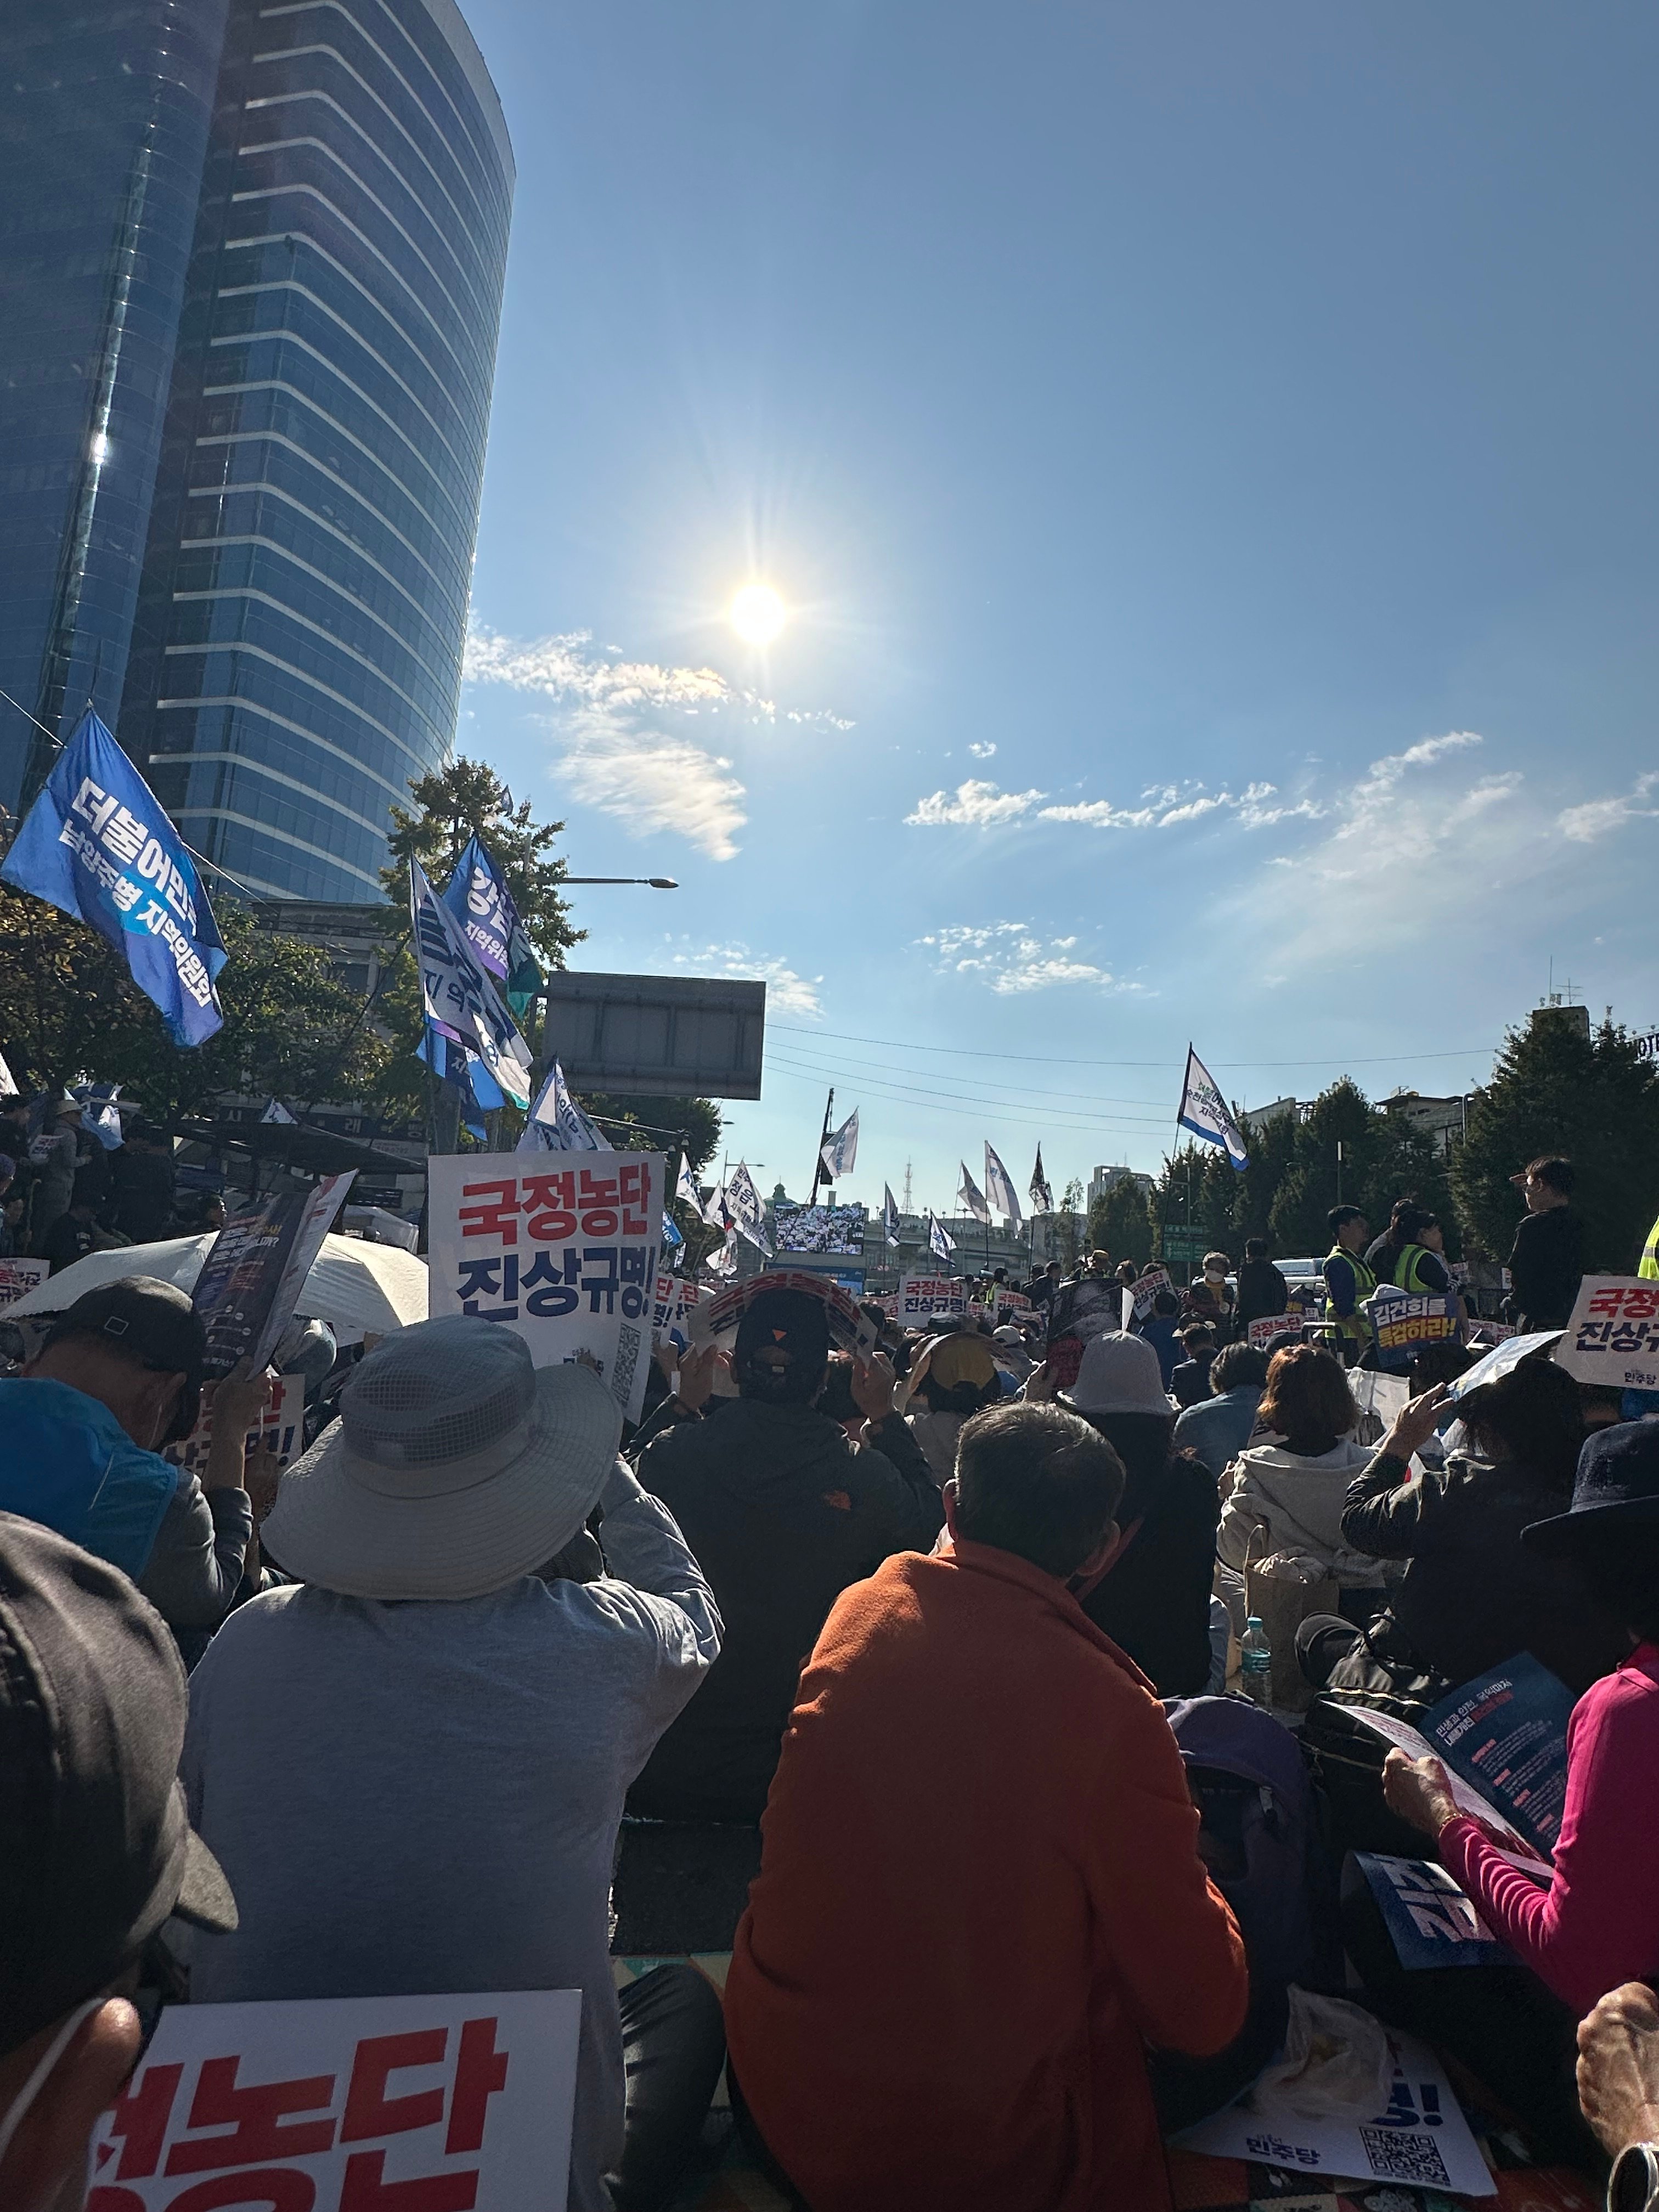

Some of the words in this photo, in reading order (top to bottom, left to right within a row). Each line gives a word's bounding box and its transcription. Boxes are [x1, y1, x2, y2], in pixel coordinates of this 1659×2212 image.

[59, 819, 144, 911] 남양주병
[137, 900, 211, 1008] 지역위원회
[459, 1161, 651, 1245] 국정농단
[456, 1246, 656, 1322] 진상규명!
[906, 1280, 963, 1297] 국정농단
[905, 1297, 967, 1312] 진상규명!
[1374, 1296, 1446, 1327] 김건희를
[1378, 1317, 1457, 1347] 특검하라!
[1246, 2137, 1321, 2165] 민주당
